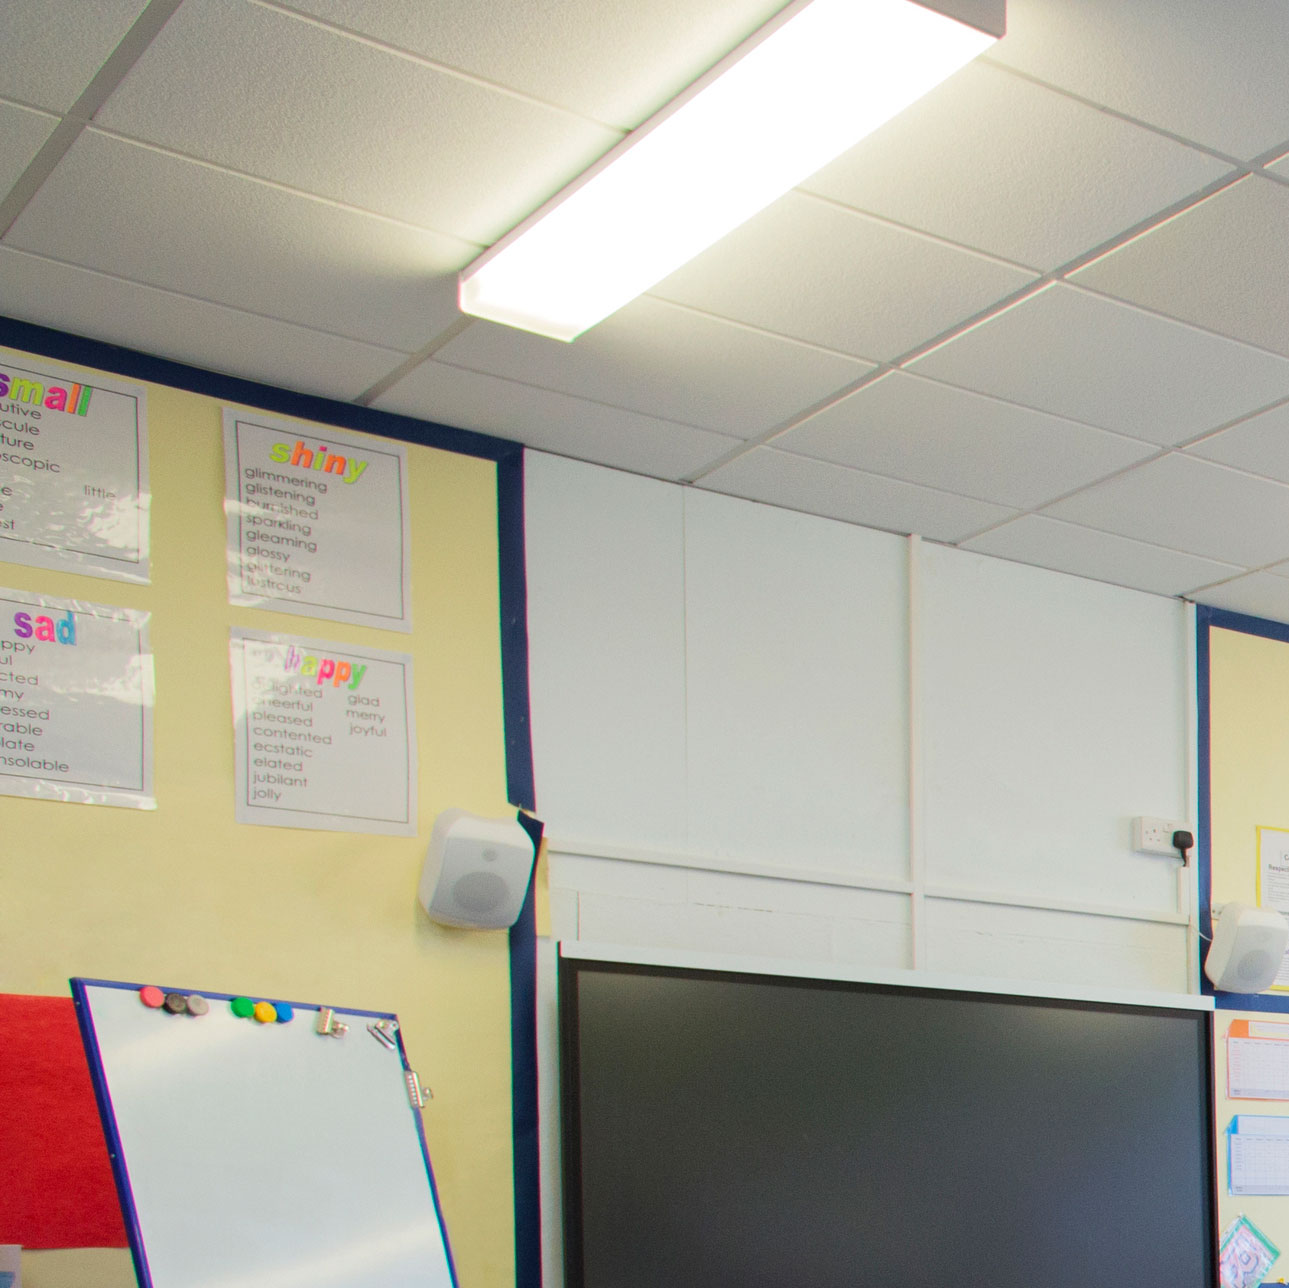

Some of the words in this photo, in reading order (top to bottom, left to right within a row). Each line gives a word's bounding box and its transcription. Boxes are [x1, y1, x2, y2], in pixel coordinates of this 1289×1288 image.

[0, 420, 40, 435] cule
[0, 453, 60, 473] scopic
[269, 441, 368, 484] shiny
[245, 467, 328, 494] glimmering
[84, 484, 116, 499] little
[246, 483, 315, 507] glistening
[246, 514, 312, 537] sparkling
[246, 529, 318, 553] gleaming
[246, 545, 290, 563] glossy
[14, 610, 77, 646] sad
[284, 645, 367, 691] happy
[253, 676, 323, 698] lighted
[253, 695, 314, 712] eerful
[347, 694, 381, 707] glad
[252, 711, 313, 728] pleased
[346, 709, 386, 723] merry
[253, 726, 332, 745] contented
[350, 724, 387, 737] joyful
[253, 741, 313, 758] ecstatic
[253, 756, 303, 772] elated
[253, 771, 308, 788] jubilant
[253, 787, 282, 802] jolly
